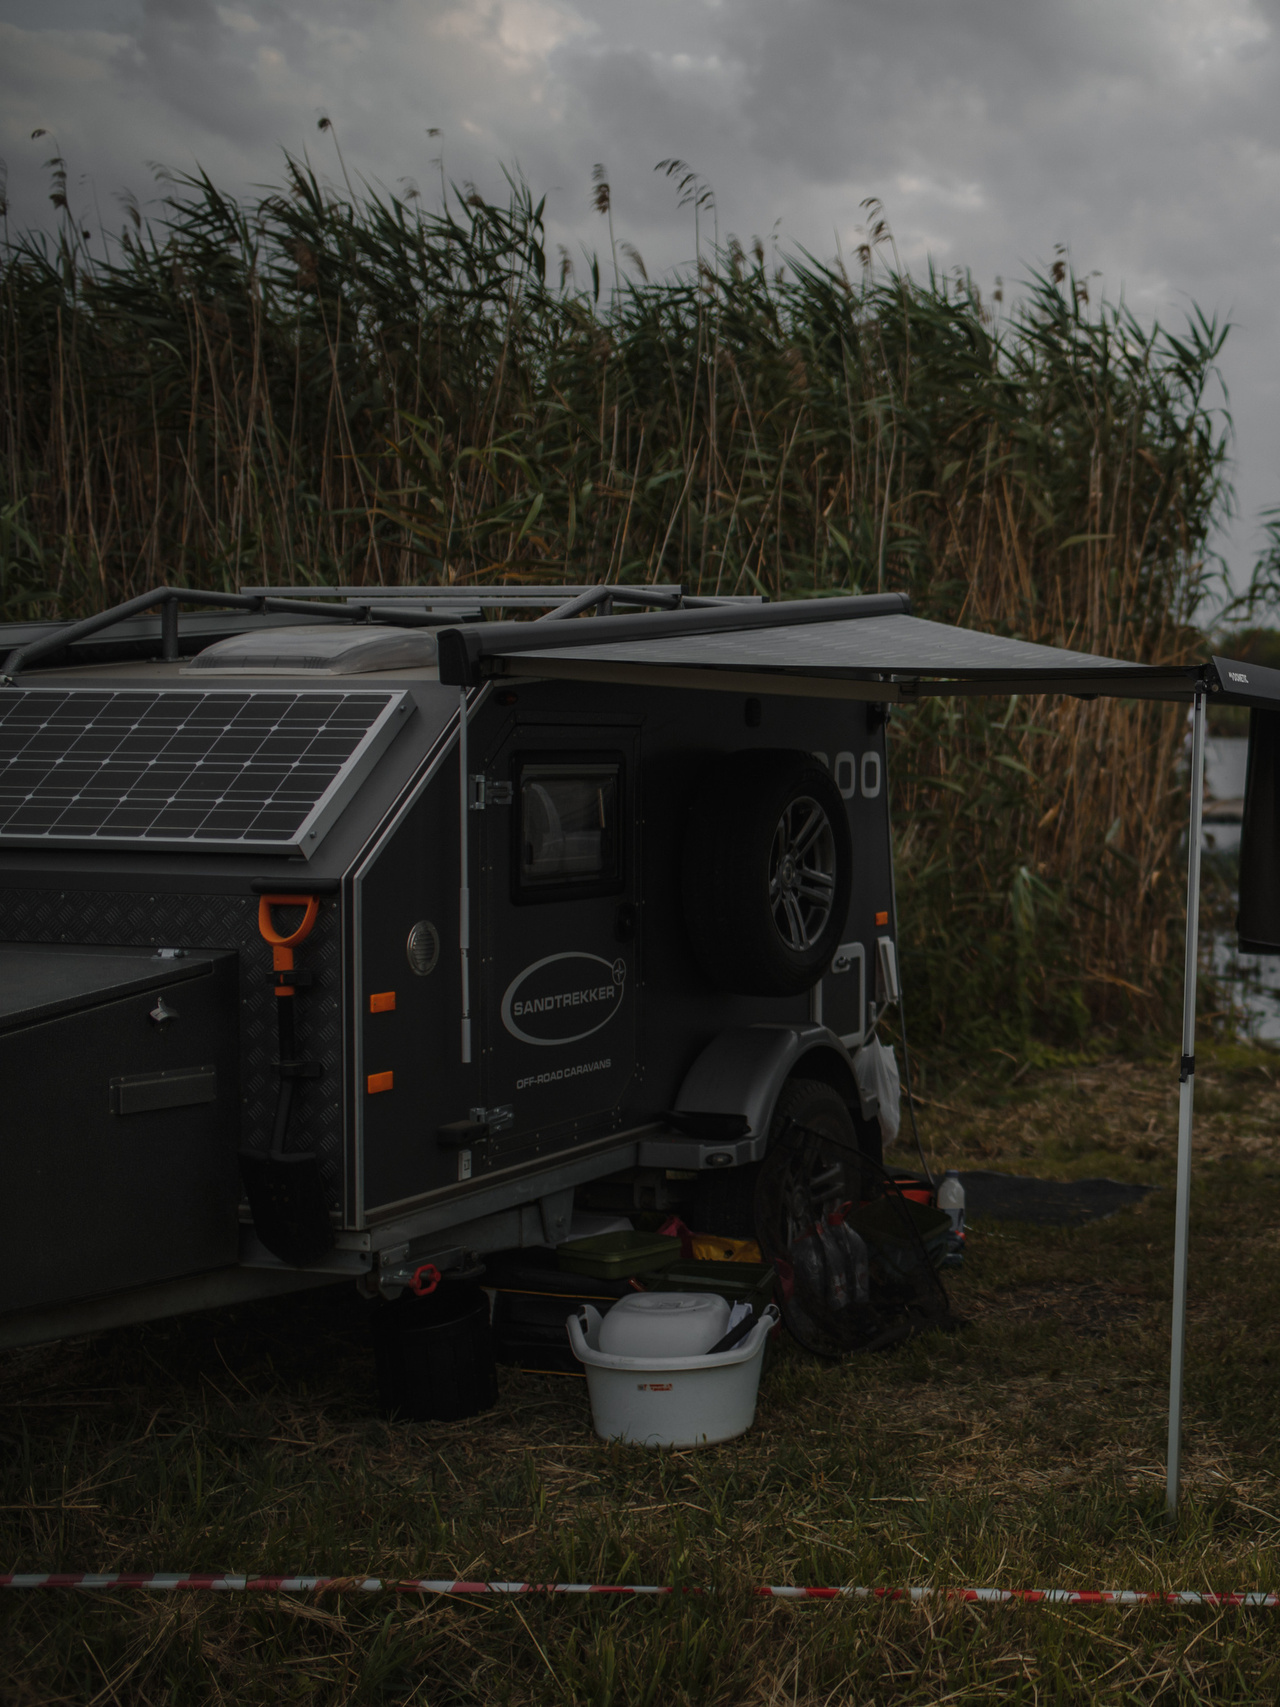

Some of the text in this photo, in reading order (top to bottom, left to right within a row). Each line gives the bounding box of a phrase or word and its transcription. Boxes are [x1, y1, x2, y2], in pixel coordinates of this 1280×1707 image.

[811, 750, 881, 800] 00
[513, 985, 616, 1017] SANDTREKKER
[516, 1058, 612, 1090] OFF-ROAD CARAVANS
